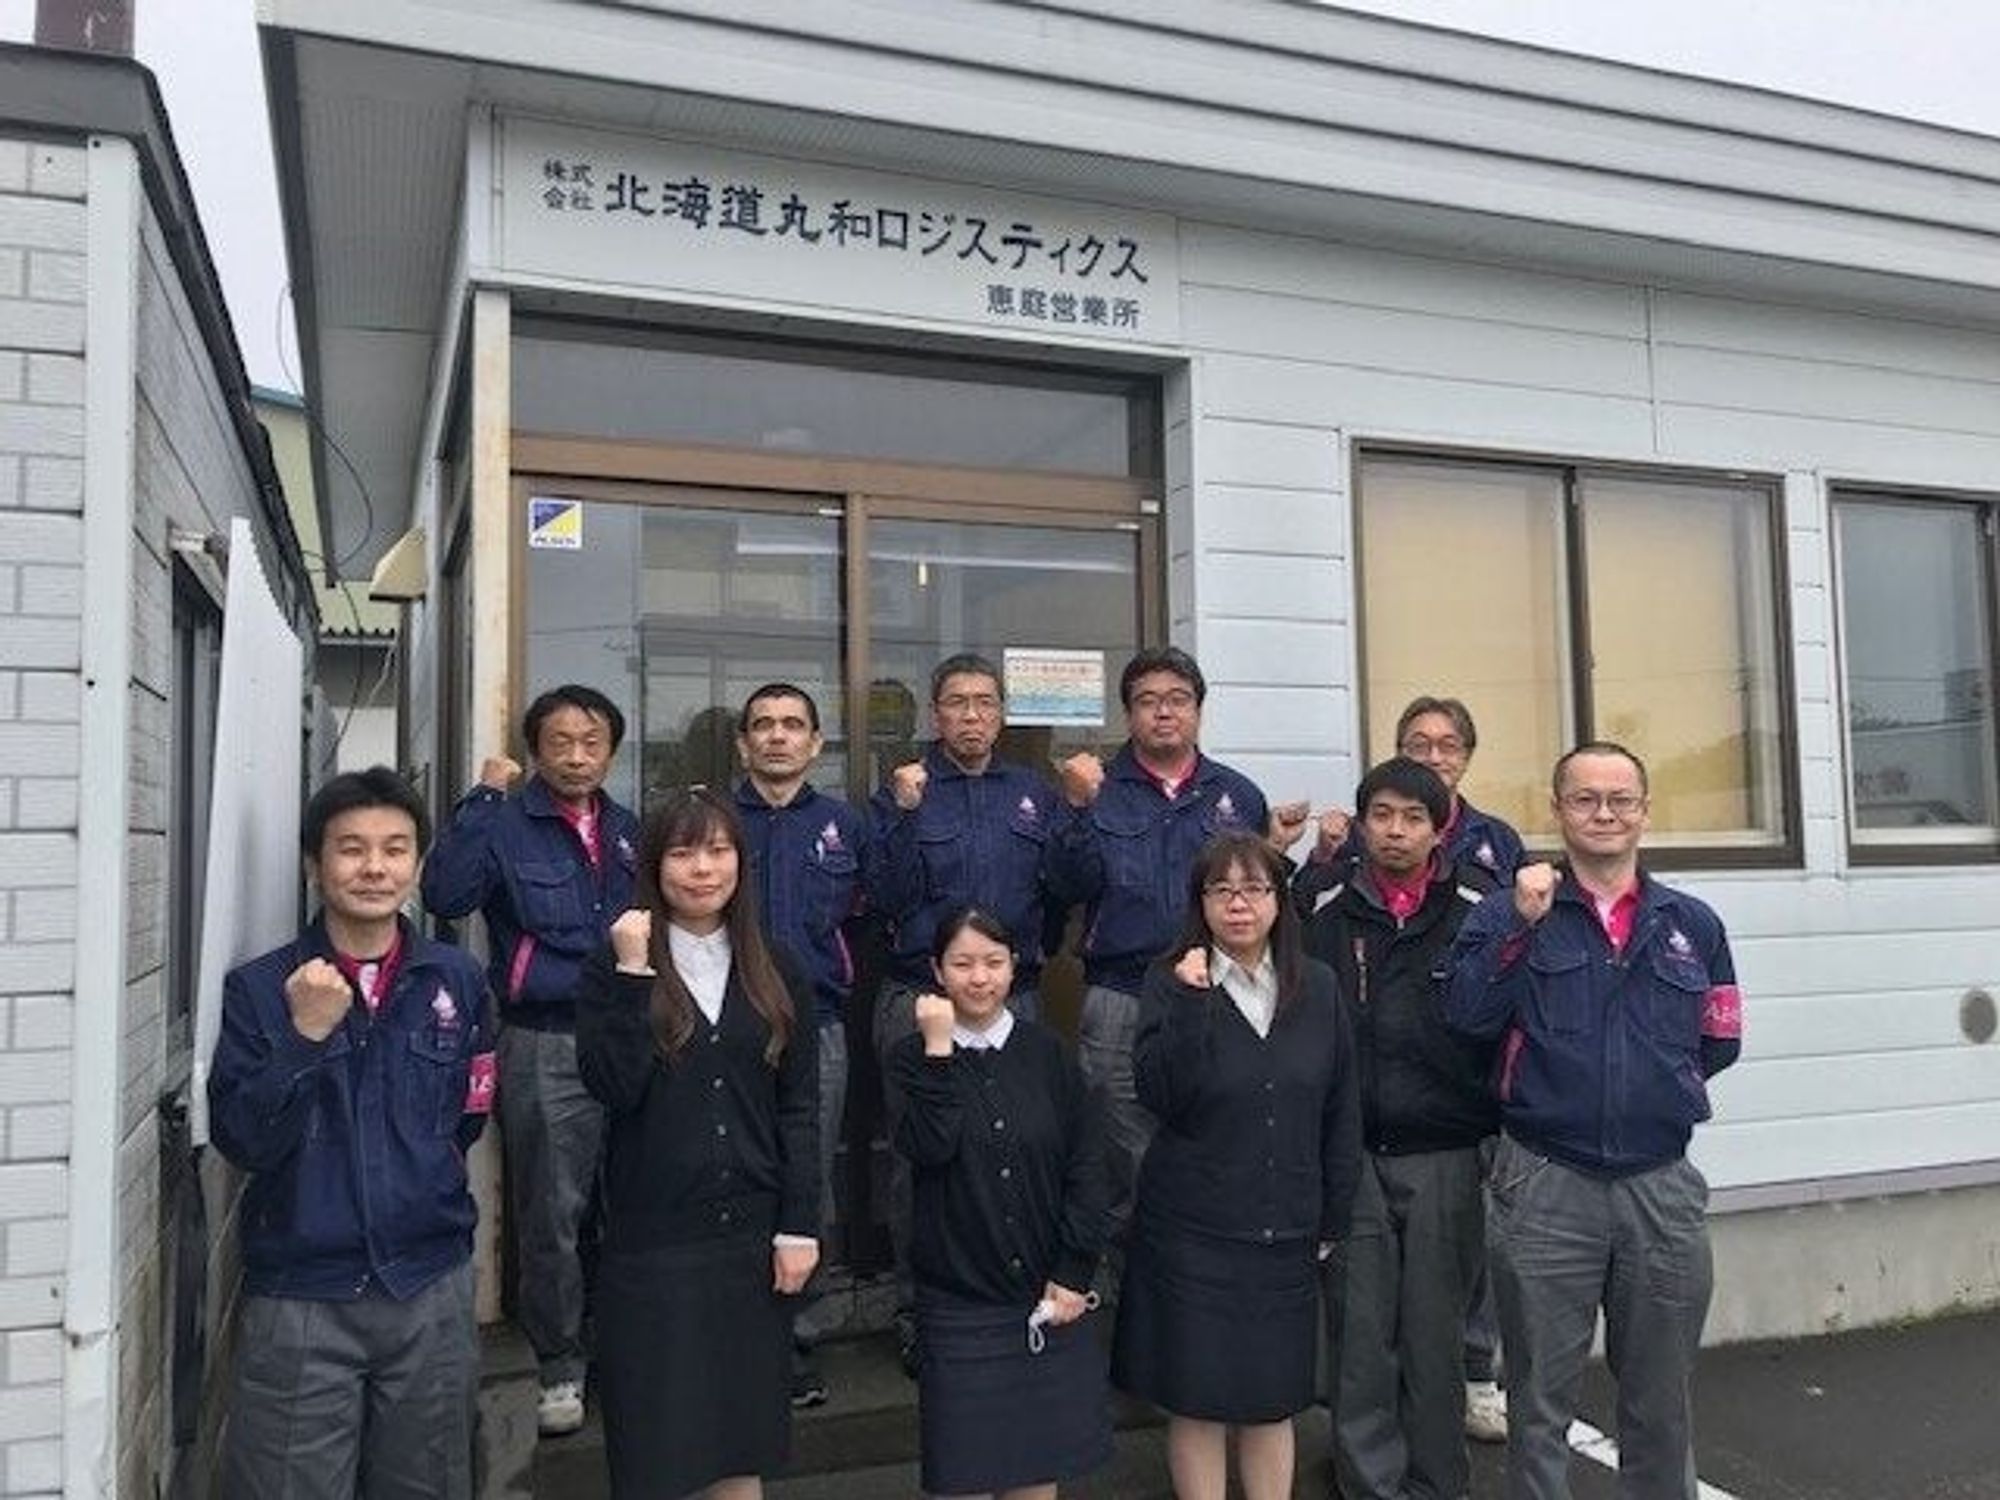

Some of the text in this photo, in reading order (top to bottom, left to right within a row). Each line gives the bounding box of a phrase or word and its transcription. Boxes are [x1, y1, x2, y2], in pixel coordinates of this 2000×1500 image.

[544, 159, 594, 187] 株式
[543, 186, 595, 212] 会社
[605, 172, 1148, 284] 北海道丸和ロジスティクス
[987, 284, 1140, 329] 恵庭営業所
